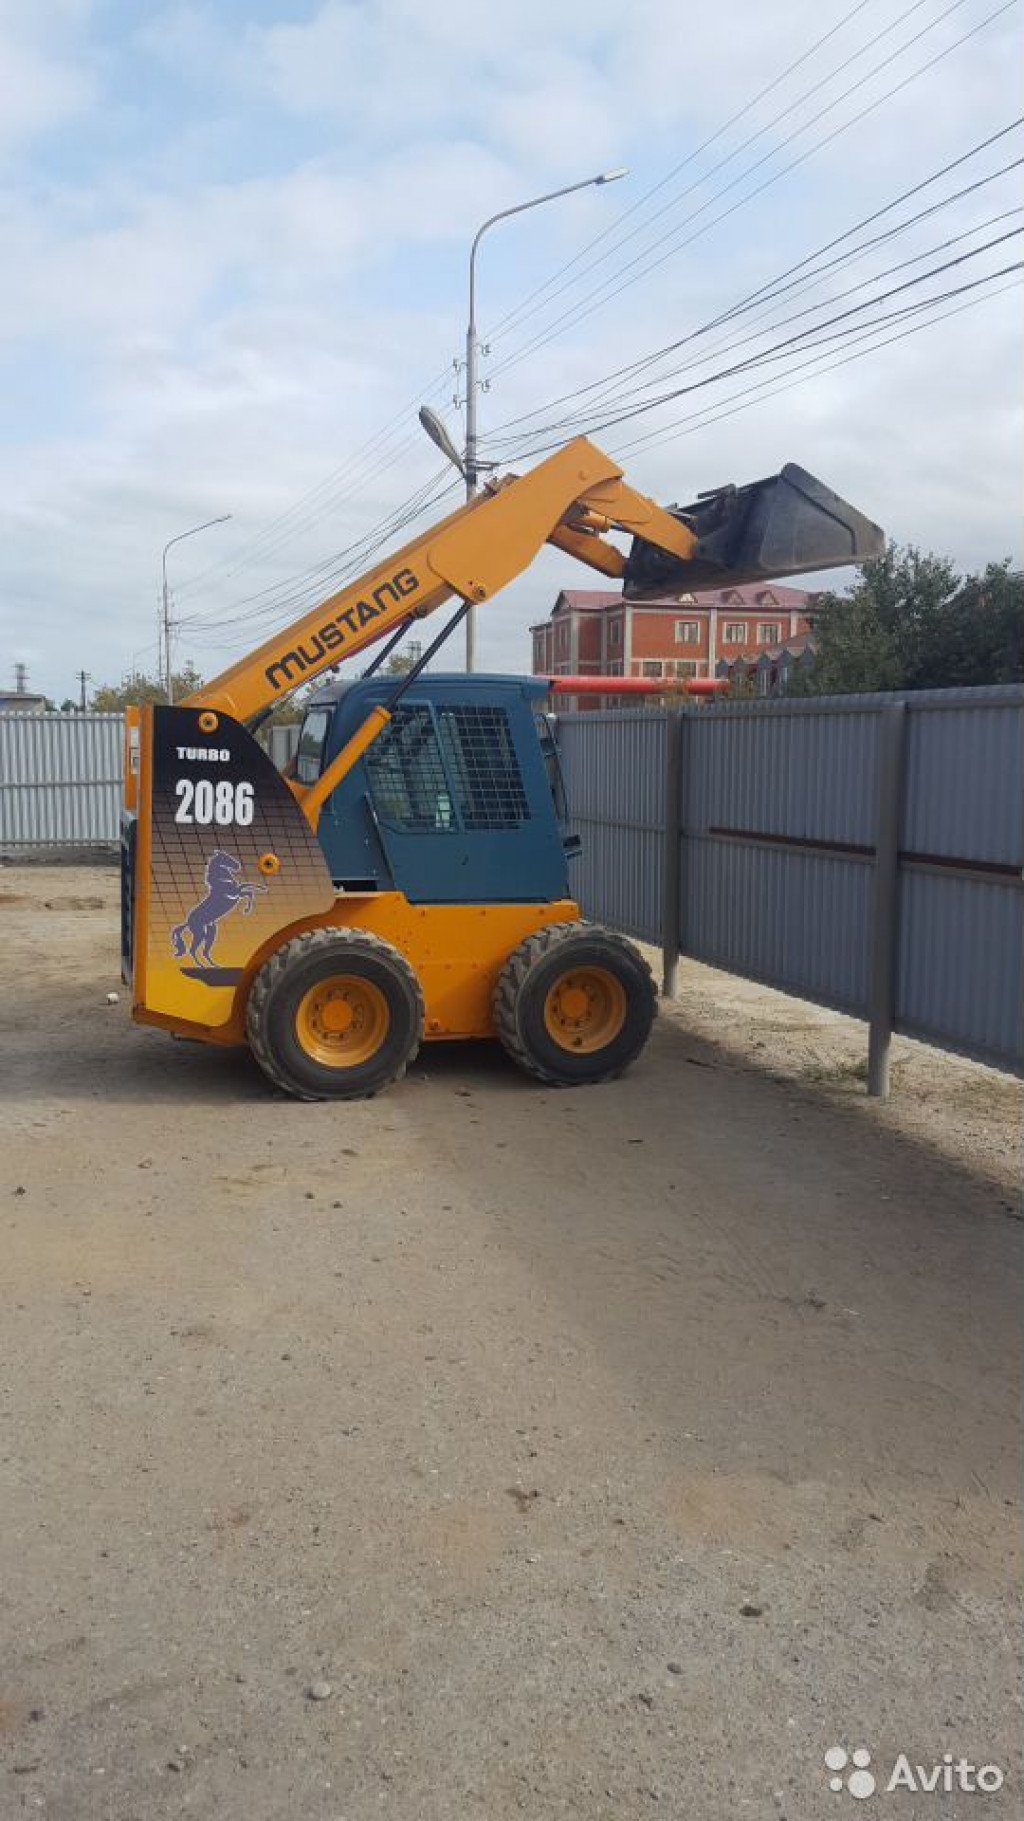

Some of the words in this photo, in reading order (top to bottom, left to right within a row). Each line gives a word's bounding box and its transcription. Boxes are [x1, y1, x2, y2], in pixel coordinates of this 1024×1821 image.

[265, 568, 420, 689] MUSTANG
[175, 746, 231, 762] TURBO
[174, 779, 255, 826] 2086
